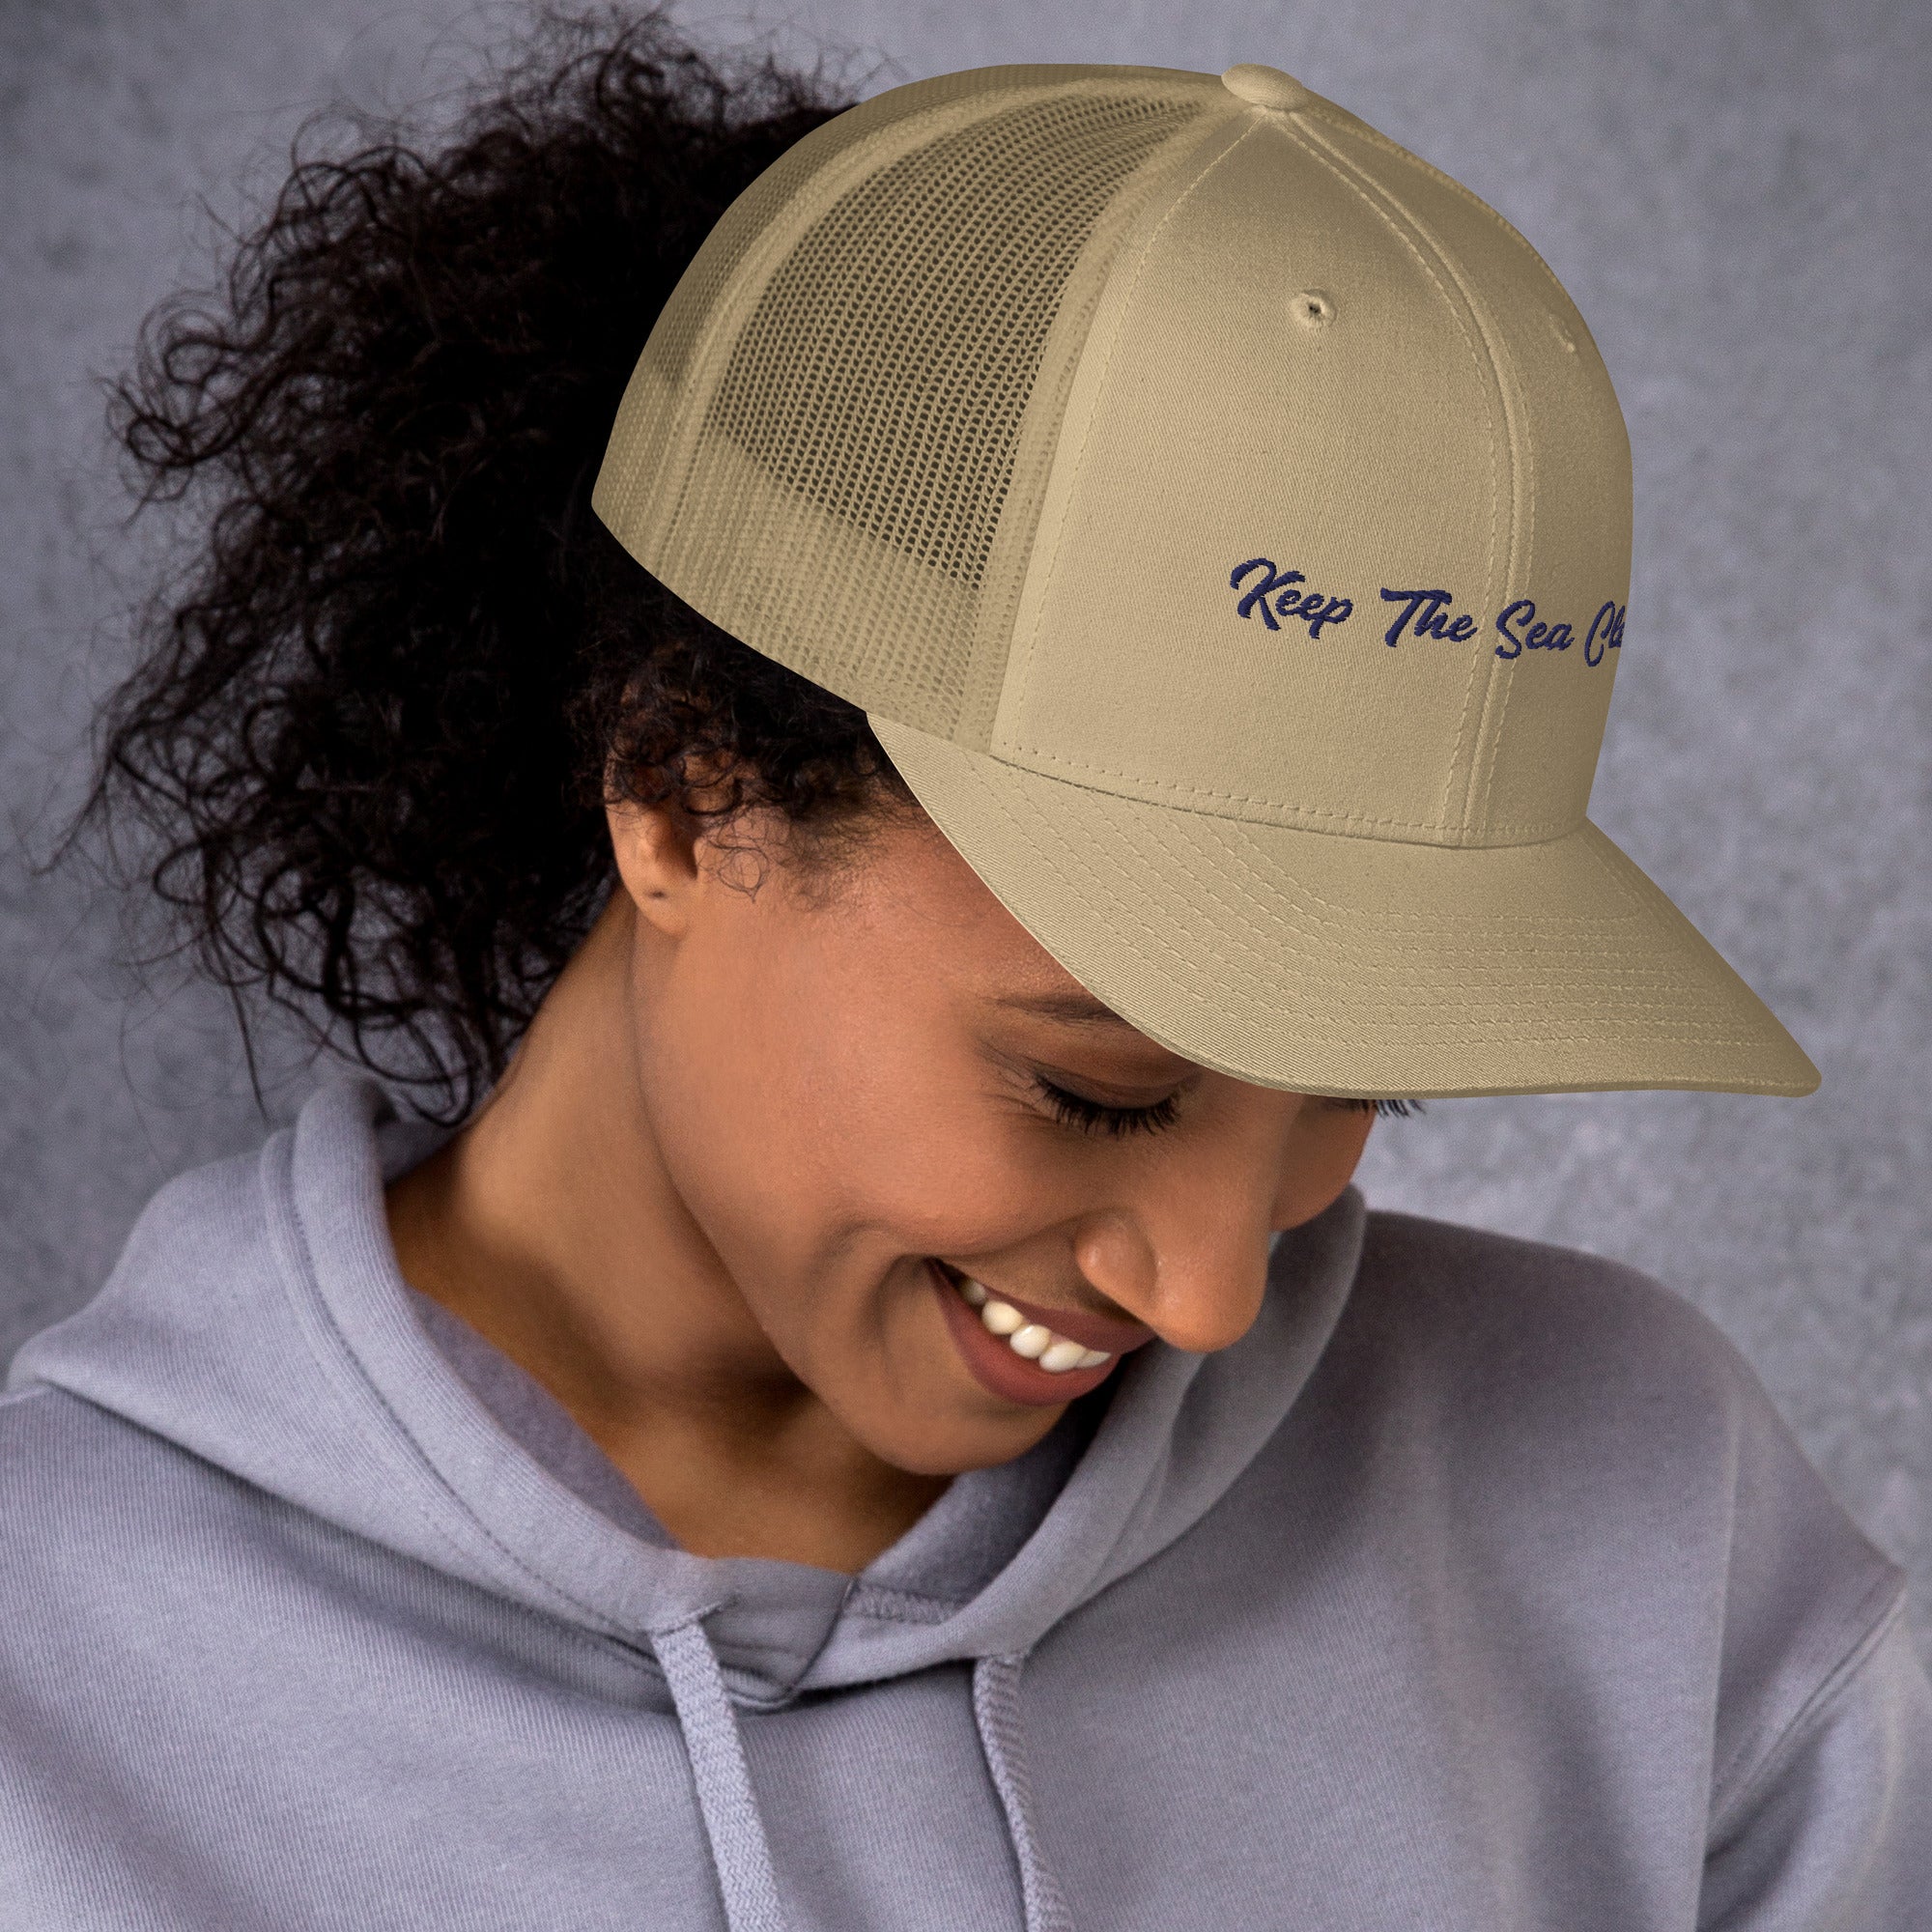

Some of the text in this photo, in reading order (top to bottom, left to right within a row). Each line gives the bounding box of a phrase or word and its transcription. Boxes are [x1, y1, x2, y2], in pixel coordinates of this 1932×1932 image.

[1230, 557, 1352, 639] Keep
[1380, 587, 1477, 647] The
[1494, 599, 1575, 660] Sea
